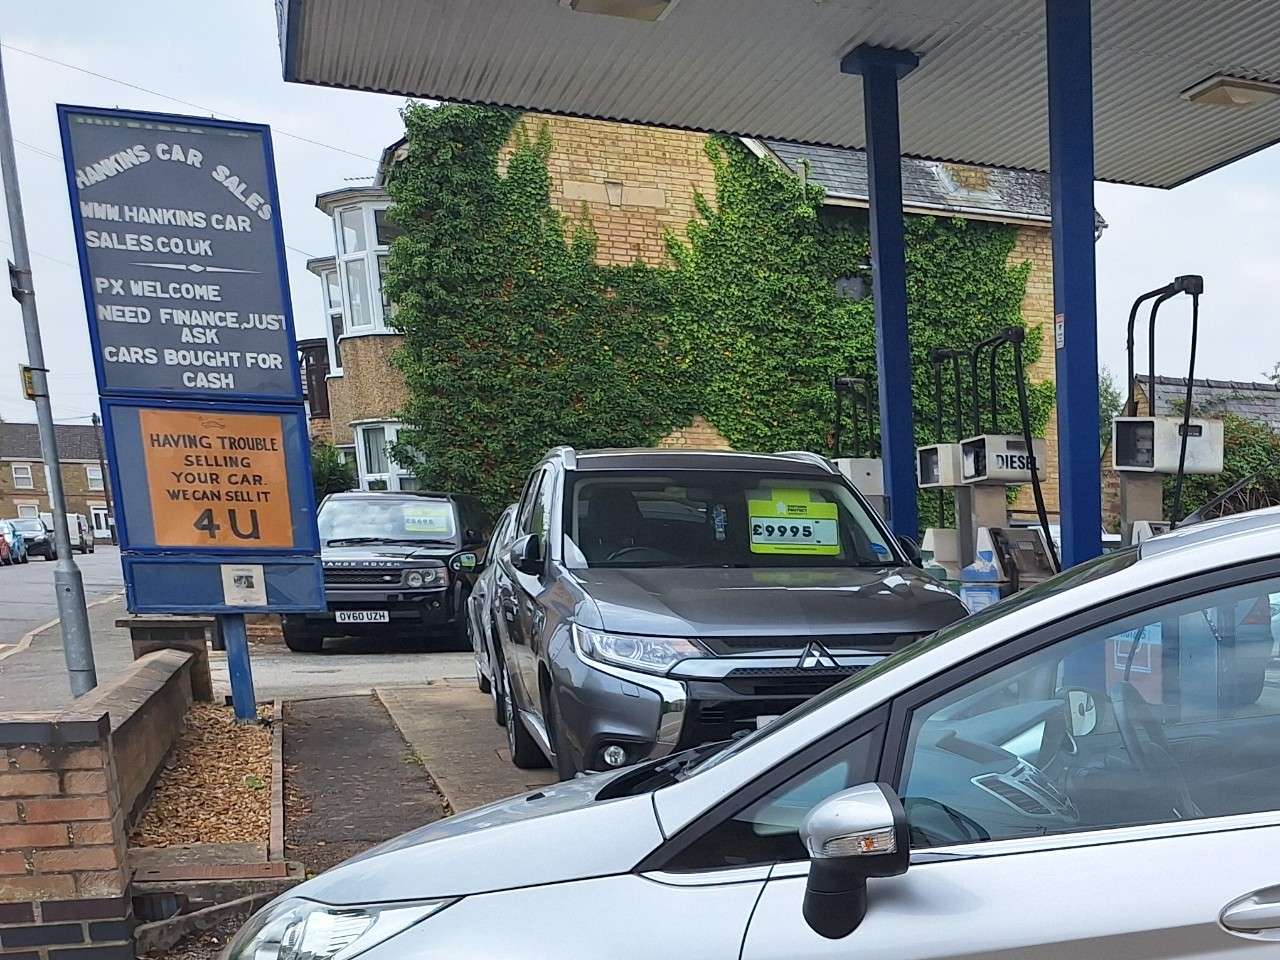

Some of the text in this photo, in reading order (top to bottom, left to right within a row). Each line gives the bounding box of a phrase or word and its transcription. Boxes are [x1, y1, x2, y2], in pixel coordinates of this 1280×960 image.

[76, 143, 272, 220] HANKINS CAR SALES
[211, 214, 251, 232] CAR
[85, 230, 213, 256] SALES.CO.UK
[96, 278, 221, 301] PX WELCOME
[98, 305, 151, 324] NEED
[181, 327, 219, 344] ASK
[104, 347, 283, 370] CARS BOUGHT FOR
[183, 372, 234, 389] CASH
[150, 433, 279, 451] HAVING TROUBLE
[184, 455, 251, 468] SELLING
[171, 472, 220, 485] YOUR
[166, 489, 271, 503] WE CAN SELL IT
[193, 508, 260, 539] 4 U
[752, 524, 812, 538] £9995
[544, 572, 597, 587] £1999
[340, 612, 386, 621] OY60 UZH
